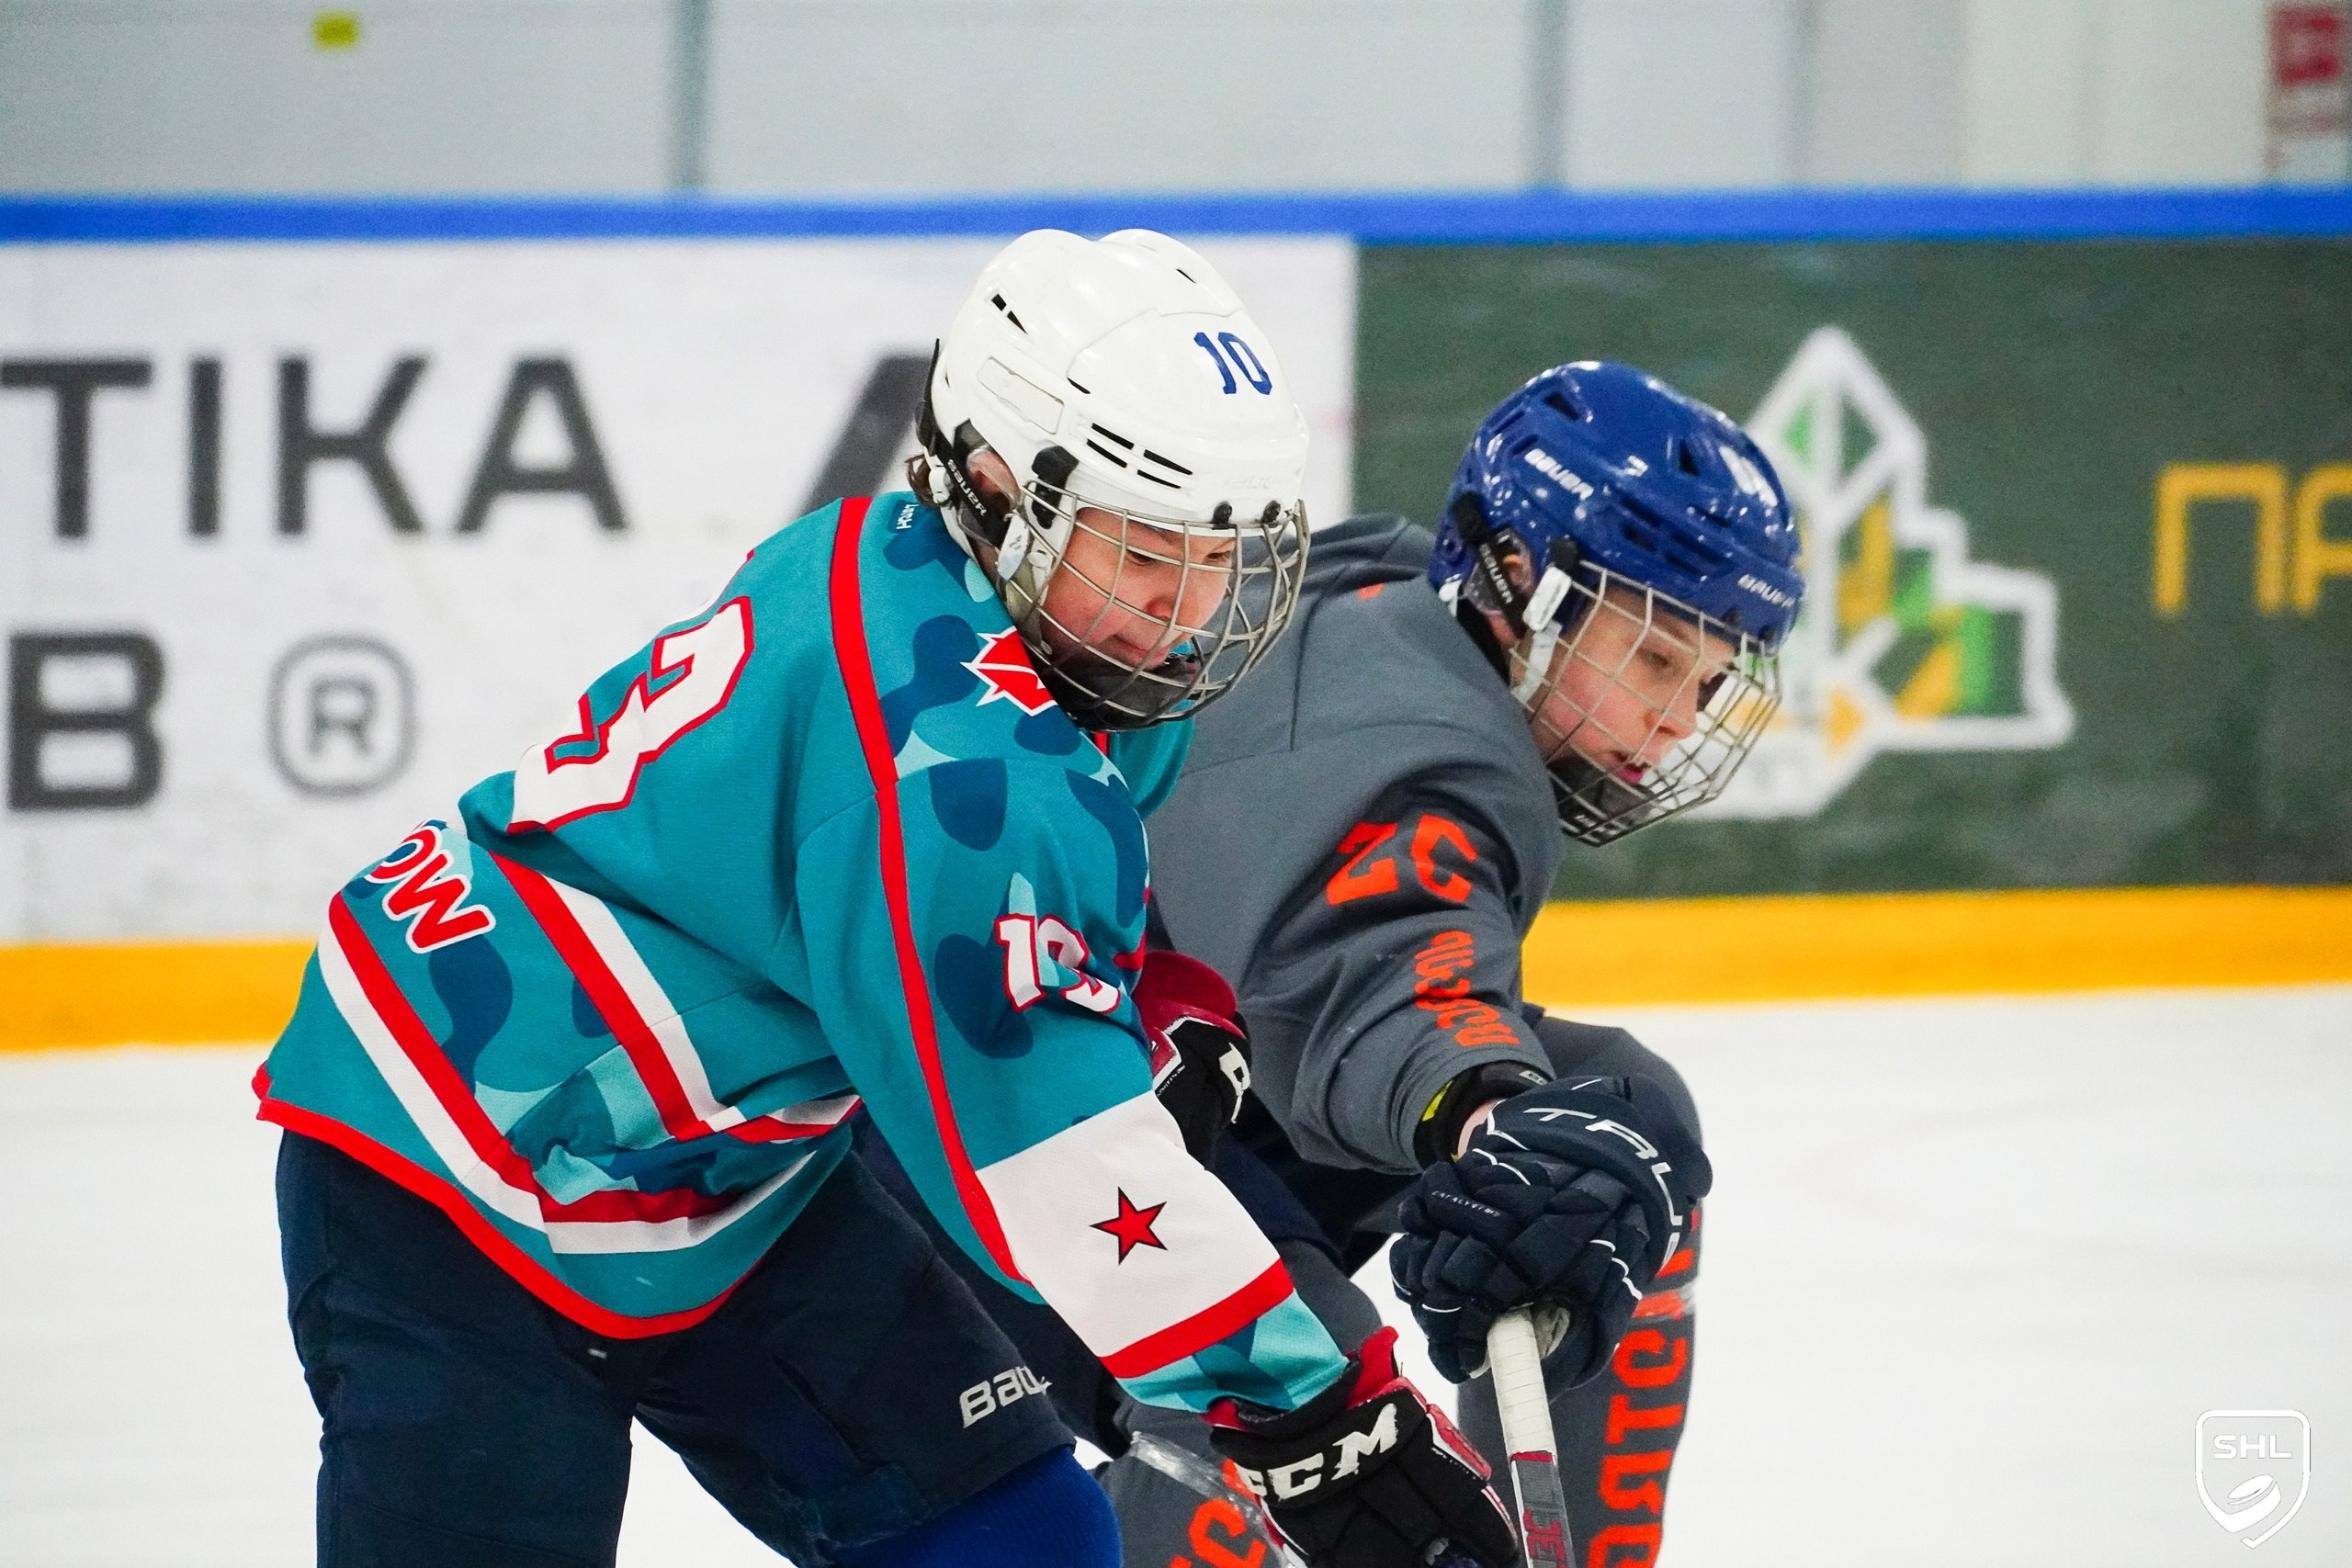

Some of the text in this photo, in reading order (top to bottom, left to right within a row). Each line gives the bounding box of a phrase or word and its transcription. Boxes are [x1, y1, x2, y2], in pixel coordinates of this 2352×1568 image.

[1193, 332, 1273, 396] 10
[947, 458, 988, 516] BAUER
[1523, 448, 1594, 500] BAUER
[1479, 543, 1514, 604] BAUER
